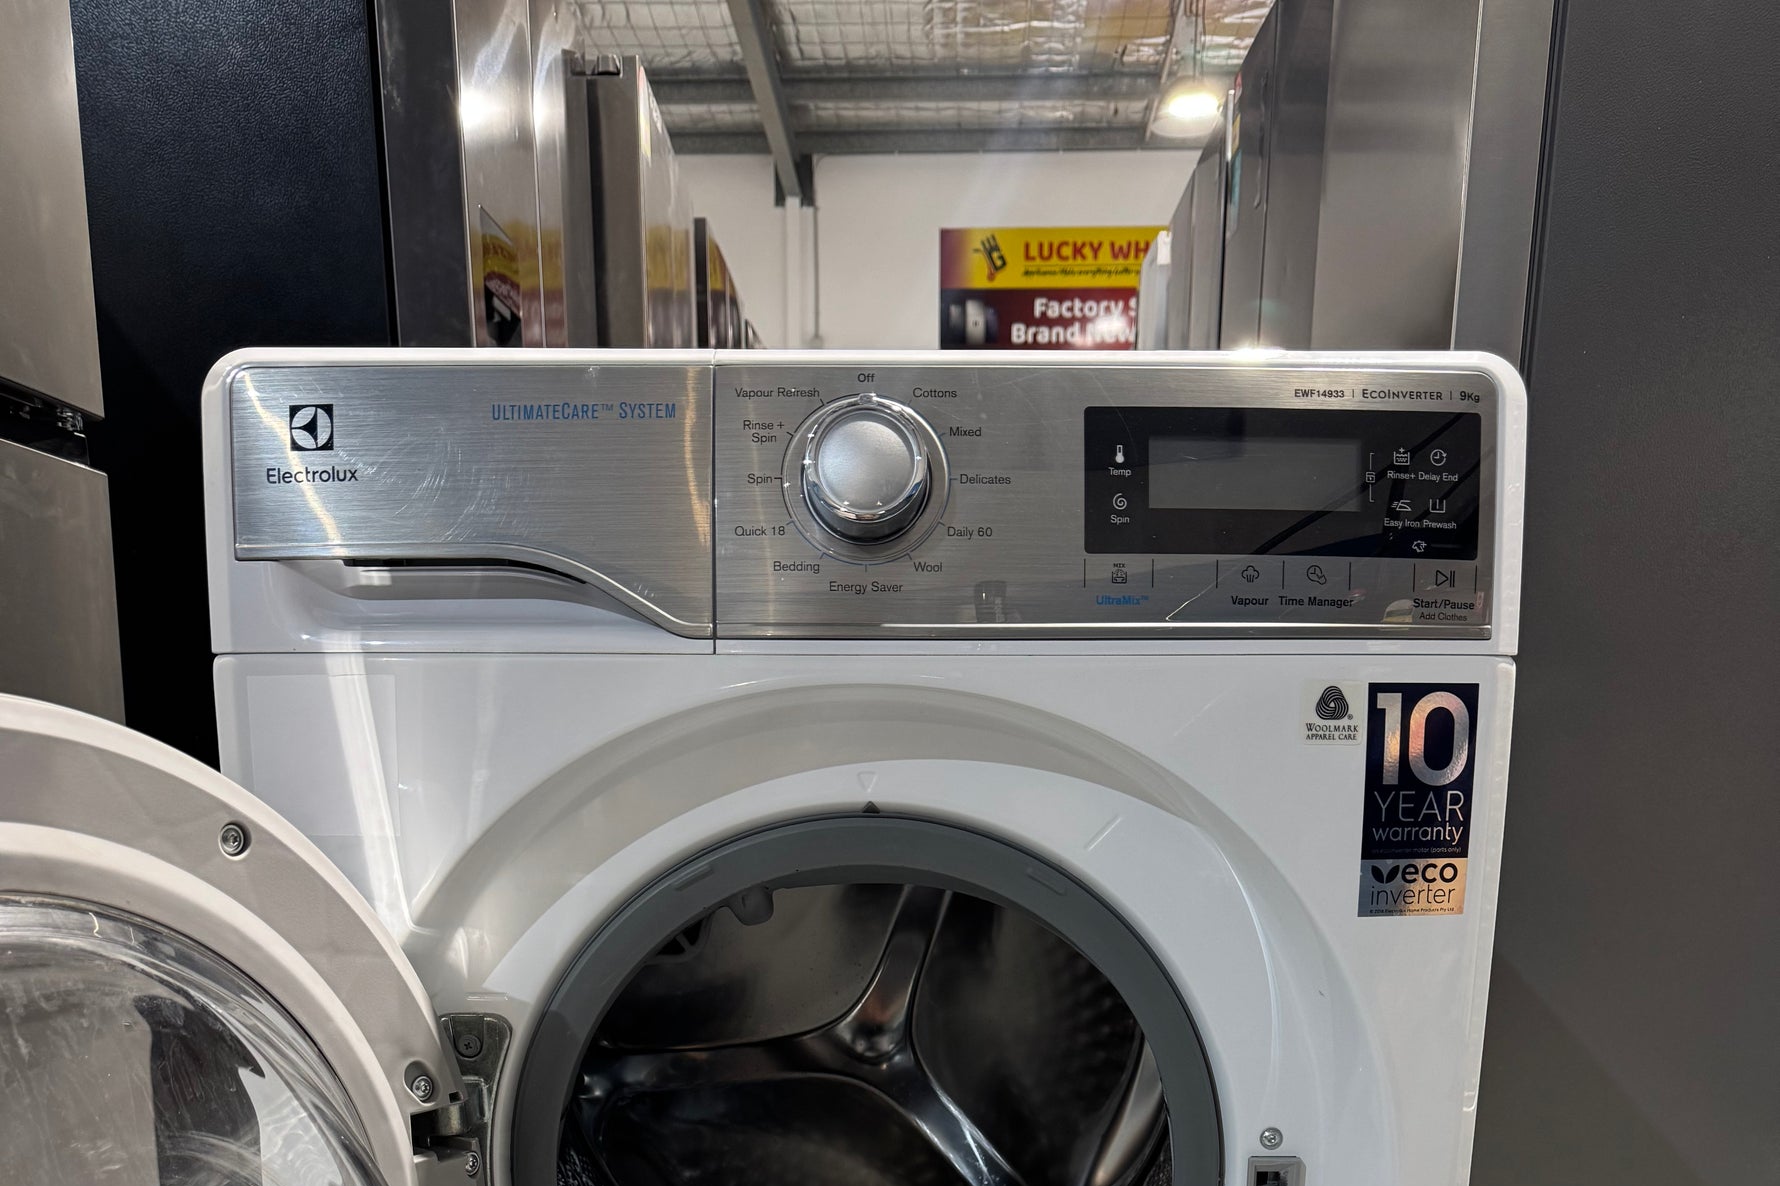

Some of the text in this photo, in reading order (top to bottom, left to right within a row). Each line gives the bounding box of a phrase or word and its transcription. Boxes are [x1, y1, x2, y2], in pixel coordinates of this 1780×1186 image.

[1024, 241, 1151, 262] LUCKY WH
[1033, 297, 1124, 319] Factory
[1010, 323, 1081, 345] Brand
[857, 373, 875, 383] Off
[735, 387, 820, 400] Vapour Refresh
[912, 387, 957, 399] Cottons
[1294, 388, 1345, 399] EWF14933
[743, 420, 774, 431] Rinse
[949, 426, 982, 438] Mixed
[751, 432, 777, 444] Spin
[266, 466, 358, 485] Electrolux
[1109, 467, 1132, 478] Temp
[1387, 470, 1458, 483] Rinse+ Delay End
[747, 474, 773, 485] Spin
[960, 474, 1011, 485] Delicates
[1110, 514, 1130, 525] Spin
[1384, 518, 1457, 530] Easy Iron Prewash
[734, 525, 785, 538] Quick 18
[947, 527, 993, 539] Daily 60
[773, 561, 820, 574] Bedding
[913, 561, 943, 573] Wool
[829, 581, 903, 595] Energy Saver
[1231, 595, 1269, 608] Vapour
[1278, 595, 1354, 610] Time Manager
[1413, 597, 1475, 610] Start/Pause
[1419, 611, 1468, 622] Add Clothes
[1305, 722, 1359, 733] WOOLMARK
[1306, 733, 1357, 741] APPAREL CARE
[1377, 690, 1470, 787] 10
[1374, 790, 1465, 823] YEAR
[1372, 822, 1464, 845] warranty
[1401, 862, 1458, 884] eco
[1370, 884, 1456, 906] inverter
